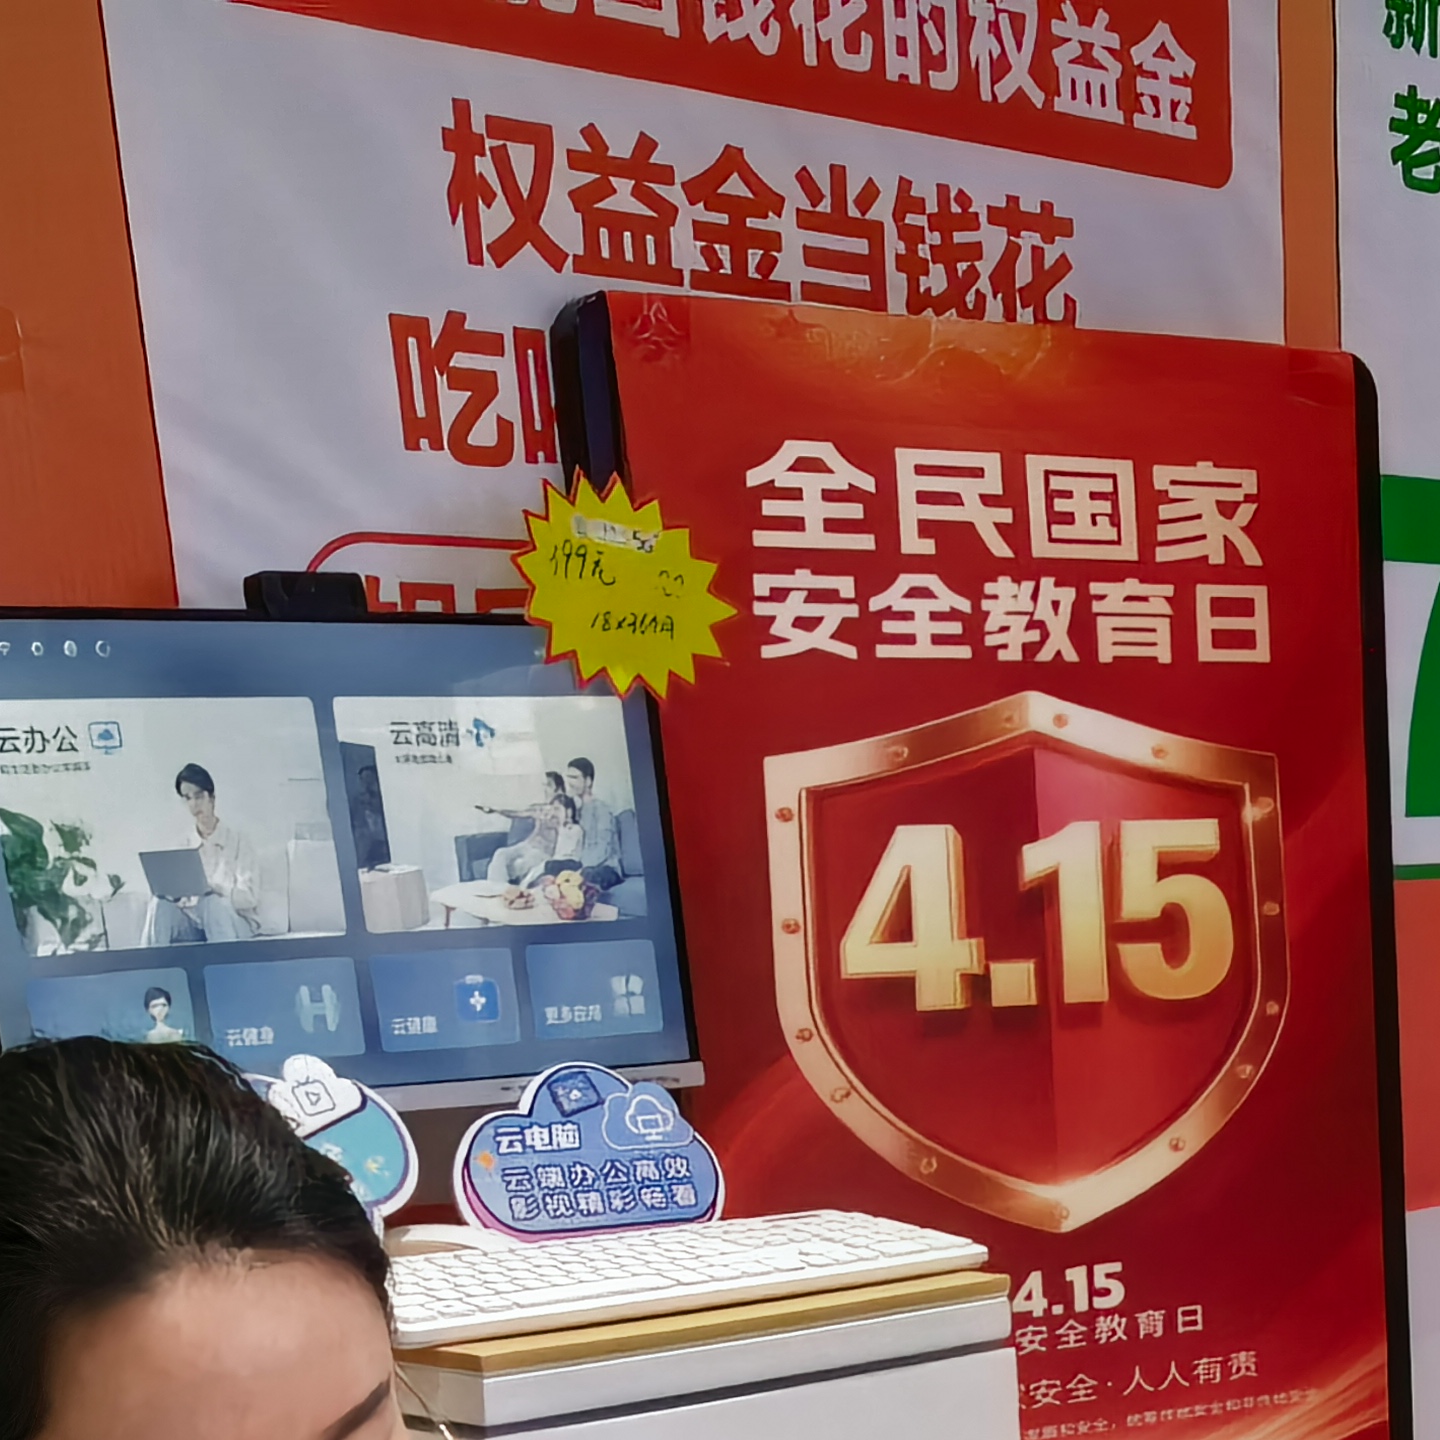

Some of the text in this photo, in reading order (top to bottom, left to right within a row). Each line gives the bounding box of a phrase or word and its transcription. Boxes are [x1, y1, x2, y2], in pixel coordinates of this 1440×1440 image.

[441, 97, 1077, 328] 权益金当钱花
[388, 310, 556, 467] 吃
[744, 438, 1264, 566] 全民国家
[752, 570, 1272, 665] 安全教育日
[840, 818, 1235, 1012] 4.15
[495, 1122, 582, 1155] 云电脑
[1012, 1262, 1126, 1318] 4.15
[1020, 1350, 1259, 1410] 安全·人人有责
